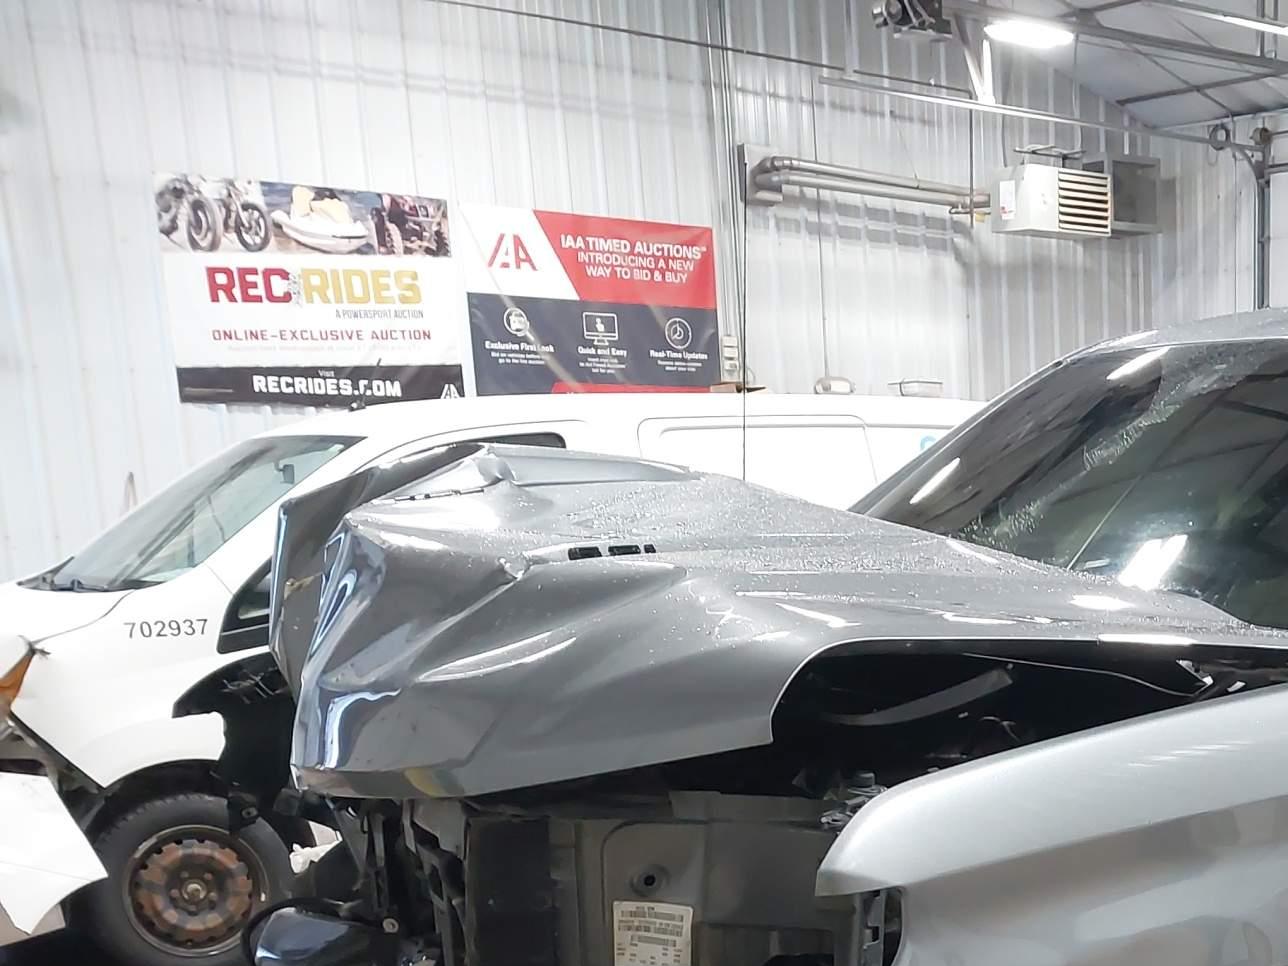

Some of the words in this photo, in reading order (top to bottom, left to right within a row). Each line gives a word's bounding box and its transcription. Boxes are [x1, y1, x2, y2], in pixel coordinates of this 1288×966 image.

[560, 234, 585, 250] IAA
[586, 236, 631, 254] TIMED
[577, 251, 656, 269] INTRODUCING
[658, 258, 666, 269] A
[668, 259, 694, 272] NEW
[585, 264, 612, 278] WAY
[614, 266, 631, 279] TO
[633, 268, 651, 281] BID
[653, 270, 663, 282] &
[665, 271, 688, 284] BUY
[205, 266, 293, 304] REC
[301, 267, 422, 305] RIDES
[342, 309, 392, 319] POWERSPORT
[393, 309, 424, 319] AUCTION
[212, 329, 365, 342] ONLINE-EXCLUSIVE
[370, 330, 432, 341] AUCTION
[485, 340, 519, 351] Exclusive
[577, 346, 596, 355] Quick
[597, 347, 609, 356] and
[611, 347, 627, 358] Easy
[649, 349, 682, 359] Real-Time
[683, 350, 709, 360] Updates
[123, 618, 208, 639] 702937
